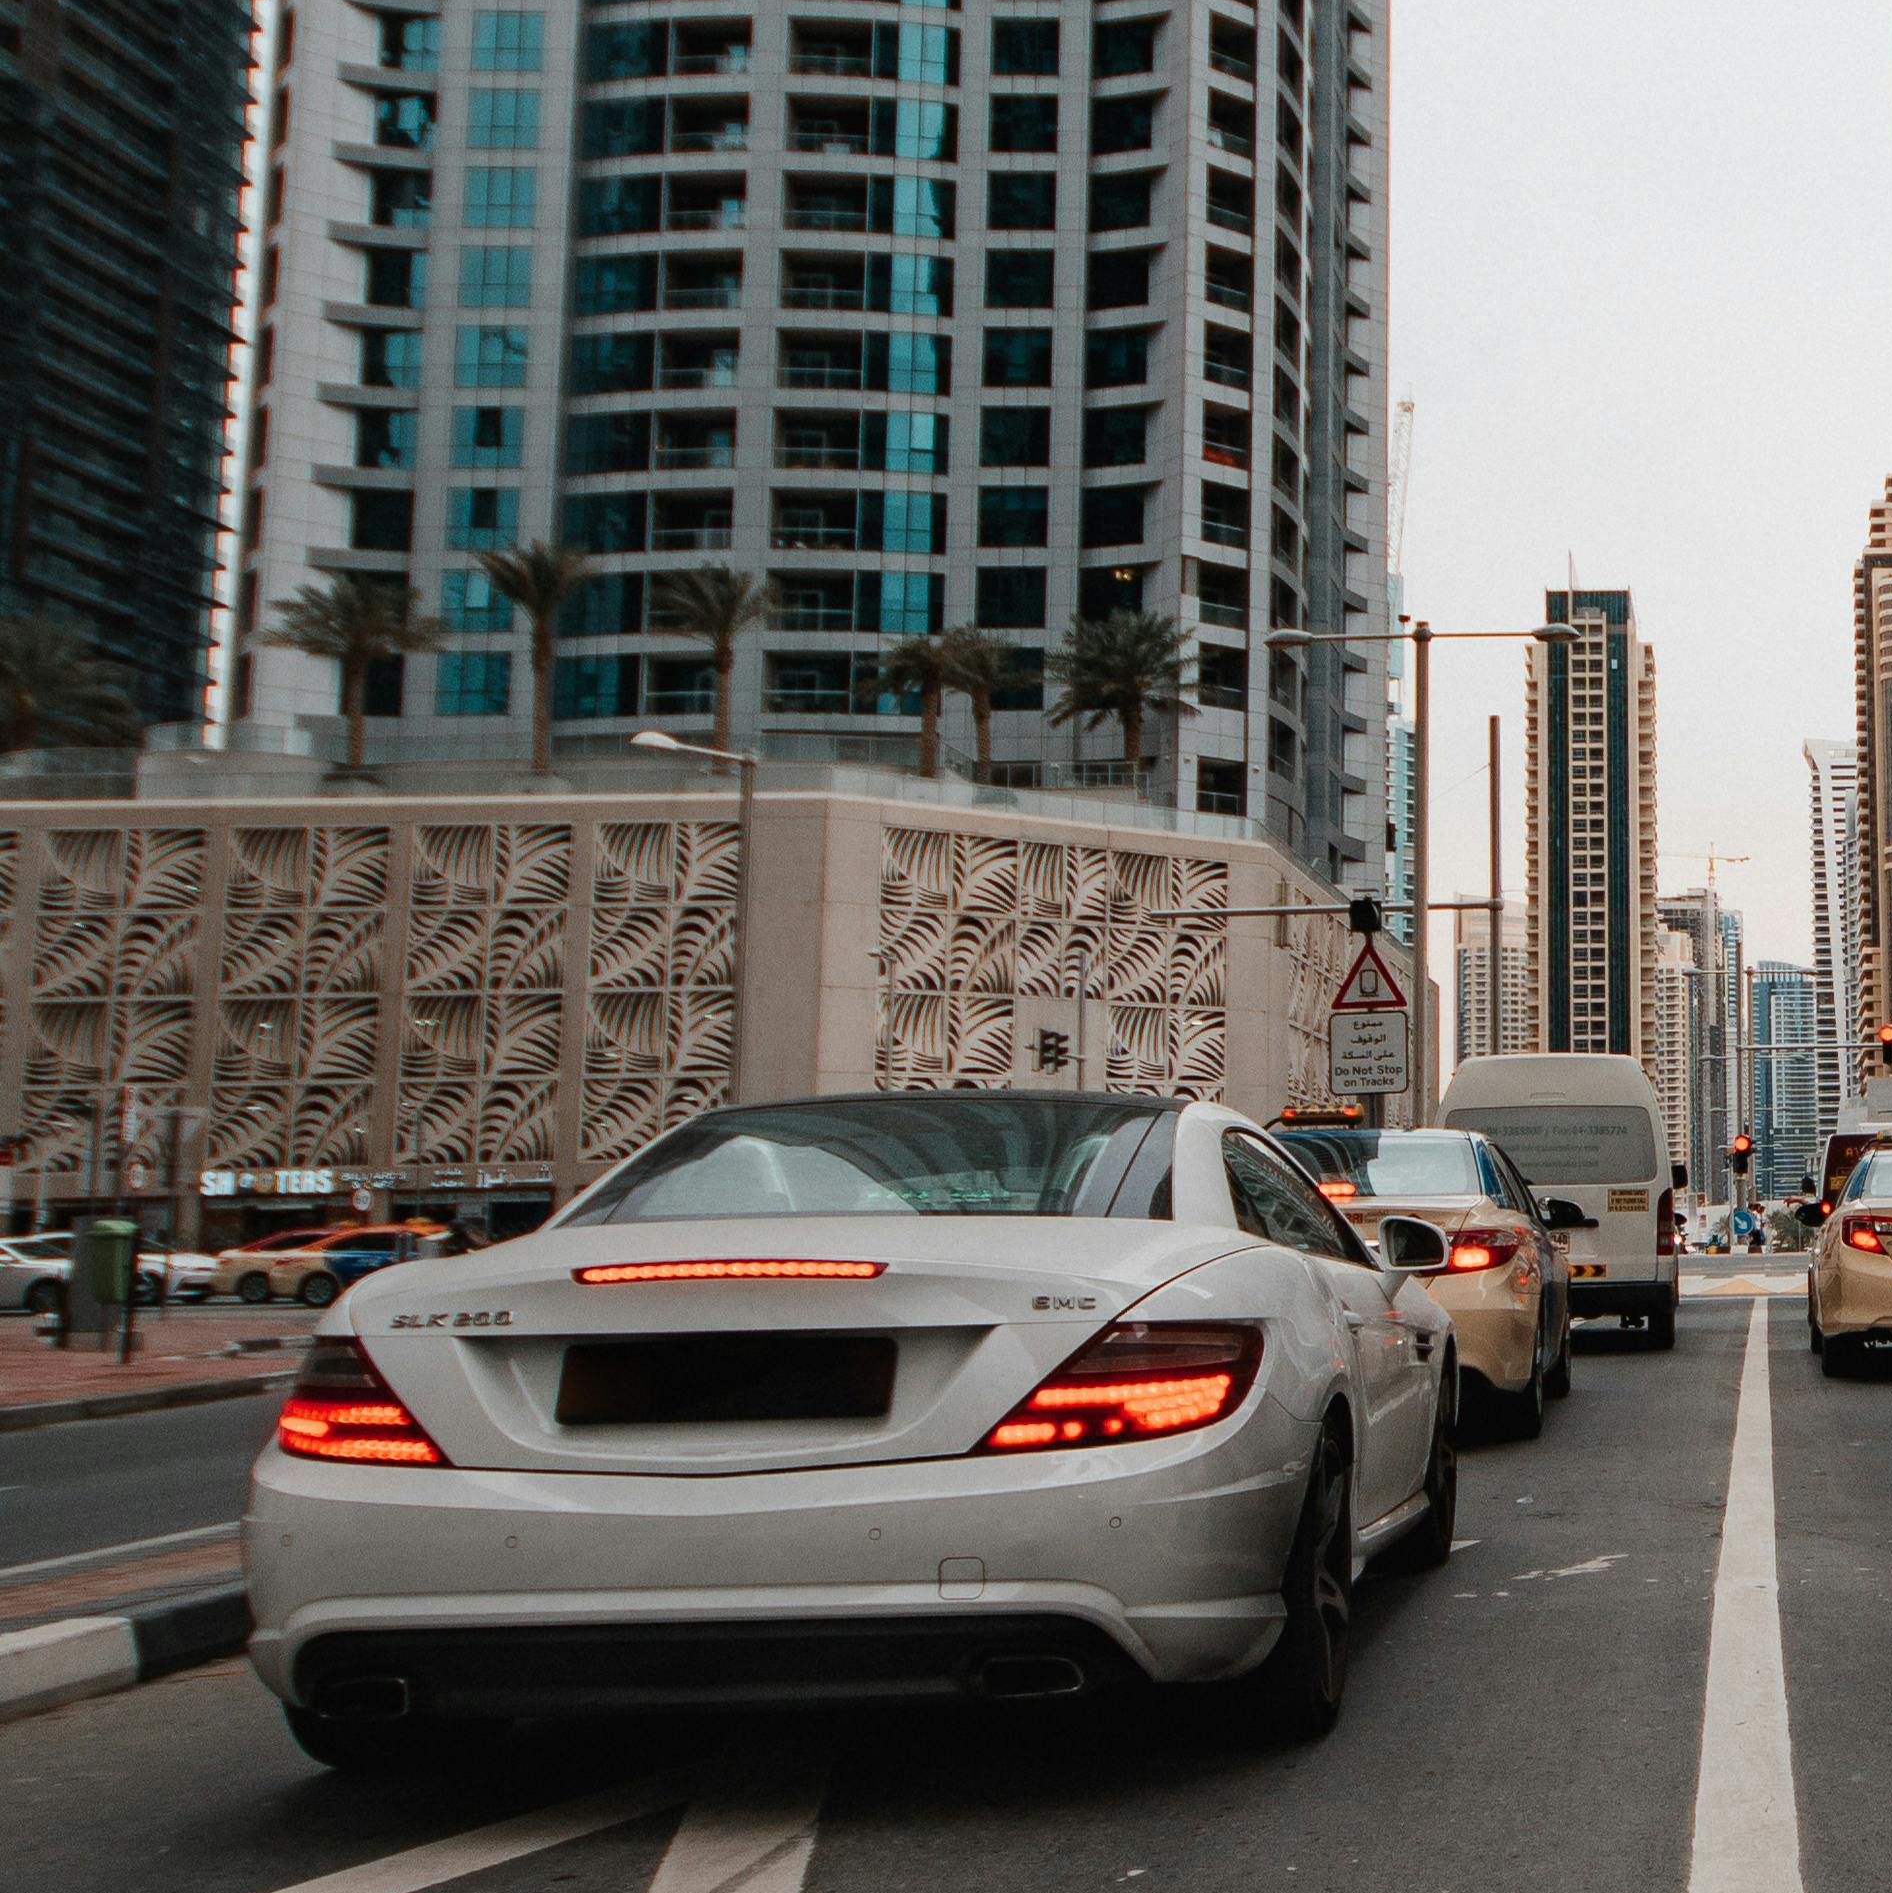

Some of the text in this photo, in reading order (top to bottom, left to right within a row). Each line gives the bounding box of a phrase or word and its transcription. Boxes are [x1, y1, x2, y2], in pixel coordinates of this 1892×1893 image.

[1353, 1019, 1383, 1030] ممنوع
[1350, 1033, 1386, 1046] الوقوف
[1341, 1050, 1395, 1061] على السكة
[1334, 1064, 1402, 1076] Do Not Stop
[1360, 1076, 1395, 1087] Tracks
[389, 1310, 514, 1328] SLK 200
